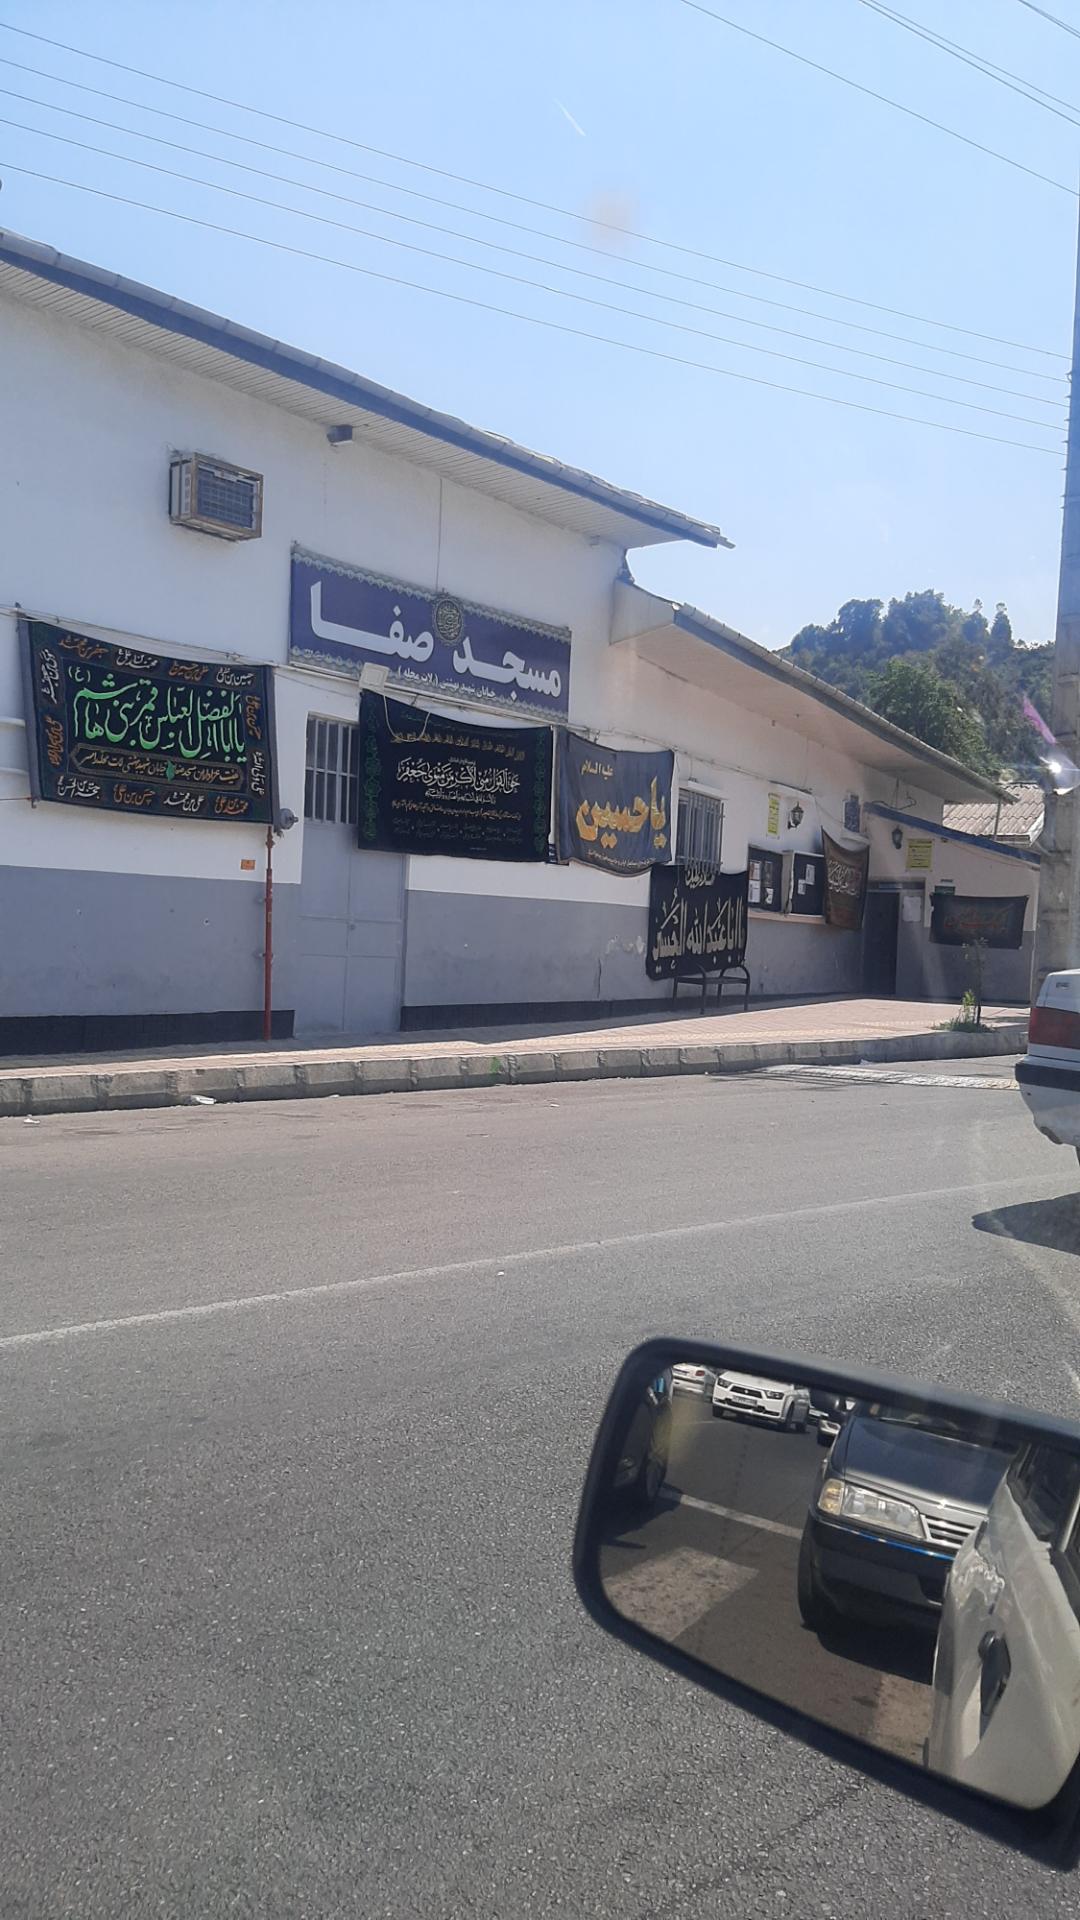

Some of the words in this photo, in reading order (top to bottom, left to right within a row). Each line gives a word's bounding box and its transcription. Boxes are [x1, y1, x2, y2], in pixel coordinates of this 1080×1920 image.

[310, 580, 434, 663] صفا
[453, 636, 562, 703] مسجد
[581, 760, 602, 775] السلام
[576, 795, 650, 849] حسین
[650, 775, 667, 850] یا
